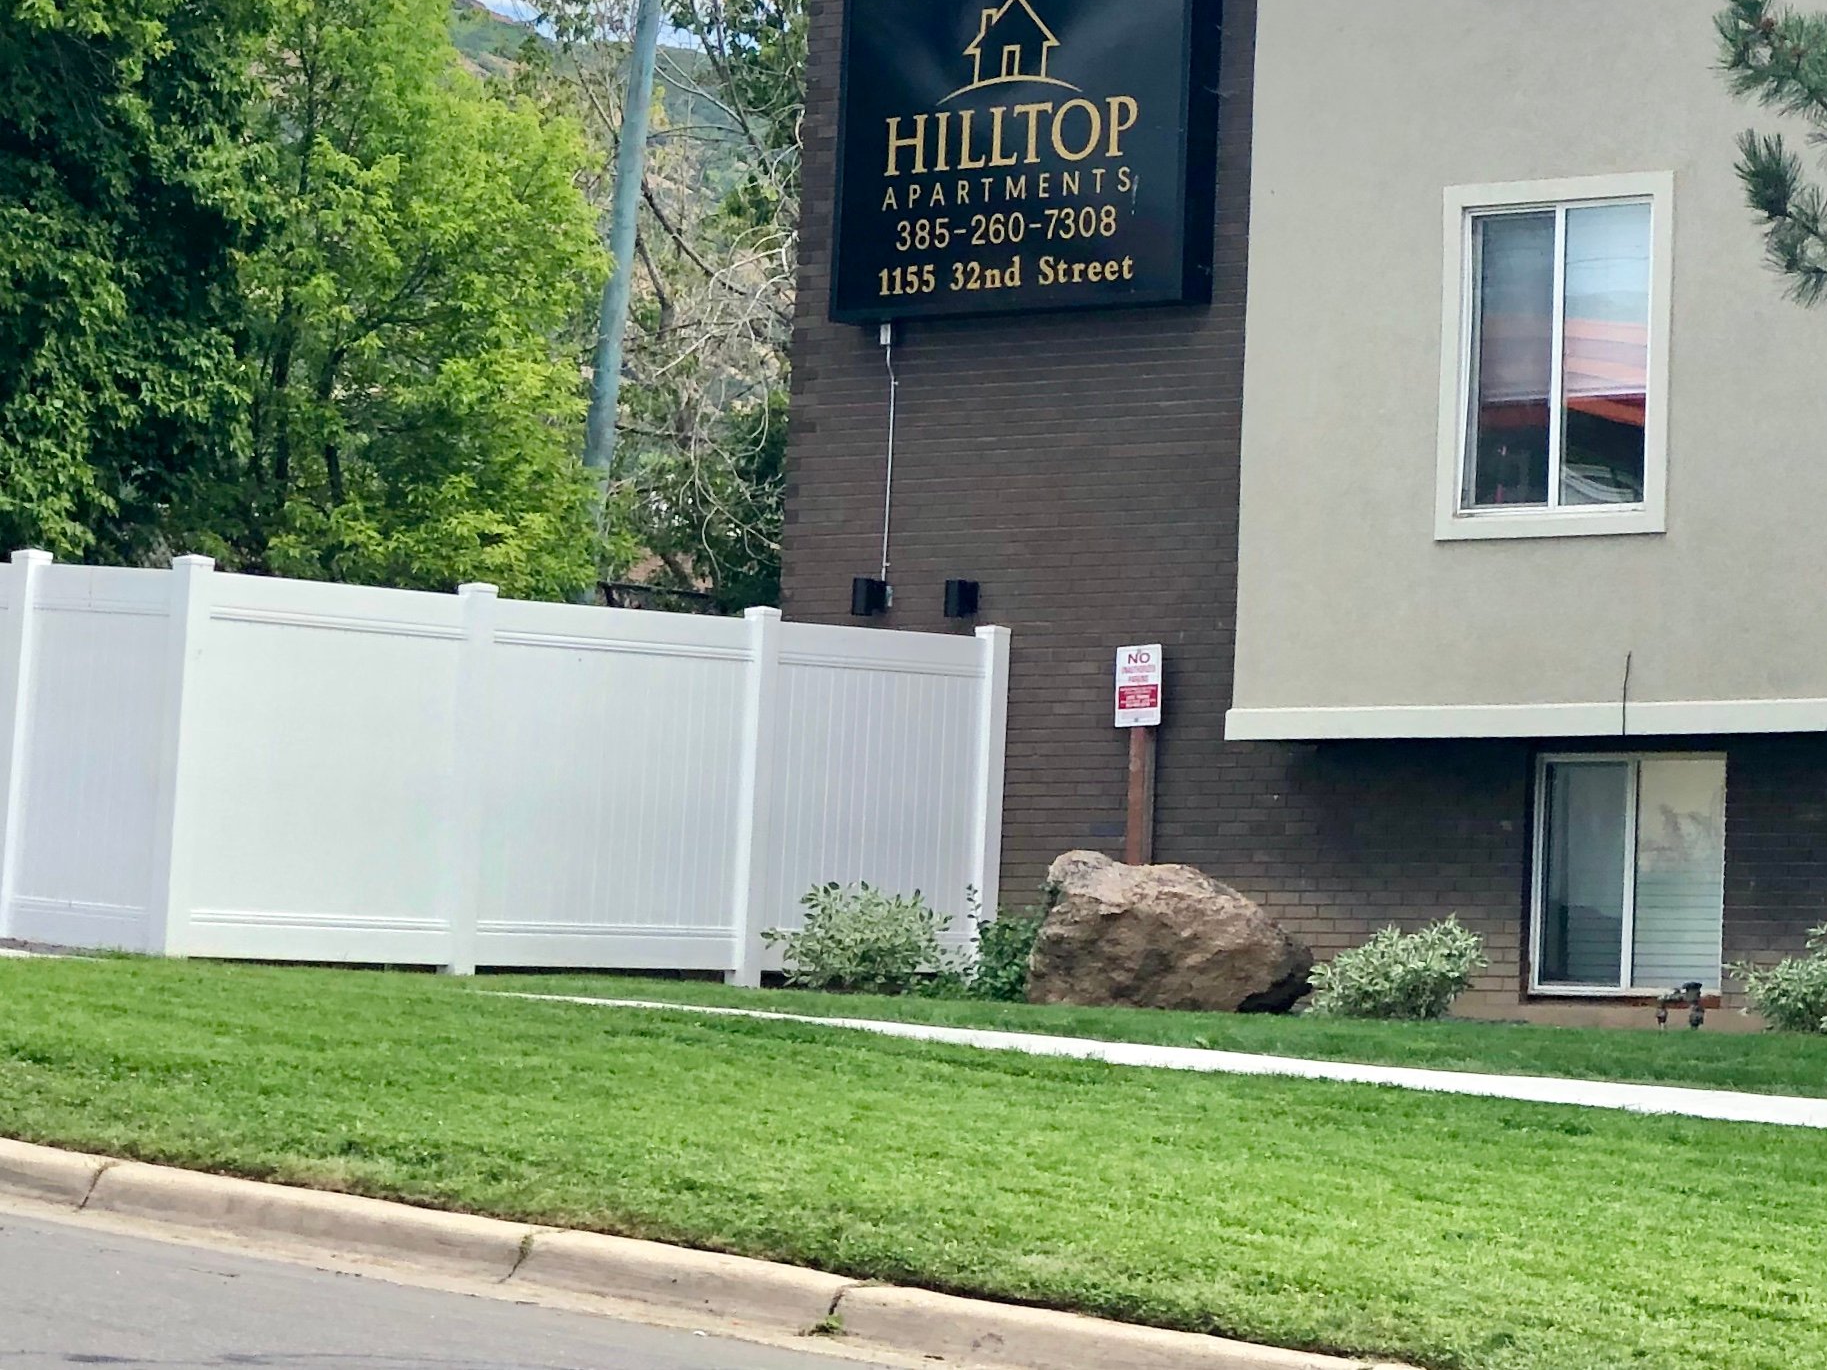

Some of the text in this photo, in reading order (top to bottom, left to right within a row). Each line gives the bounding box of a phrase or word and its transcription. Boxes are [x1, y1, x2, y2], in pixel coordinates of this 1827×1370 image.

[883, 95, 1139, 177] HILLTOP
[882, 166, 1132, 212] APARTMENTS
[895, 205, 1117, 252] 385-260-7308
[878, 255, 1134, 296] 1155 32nd Street
[1128, 652, 1151, 664] NO
